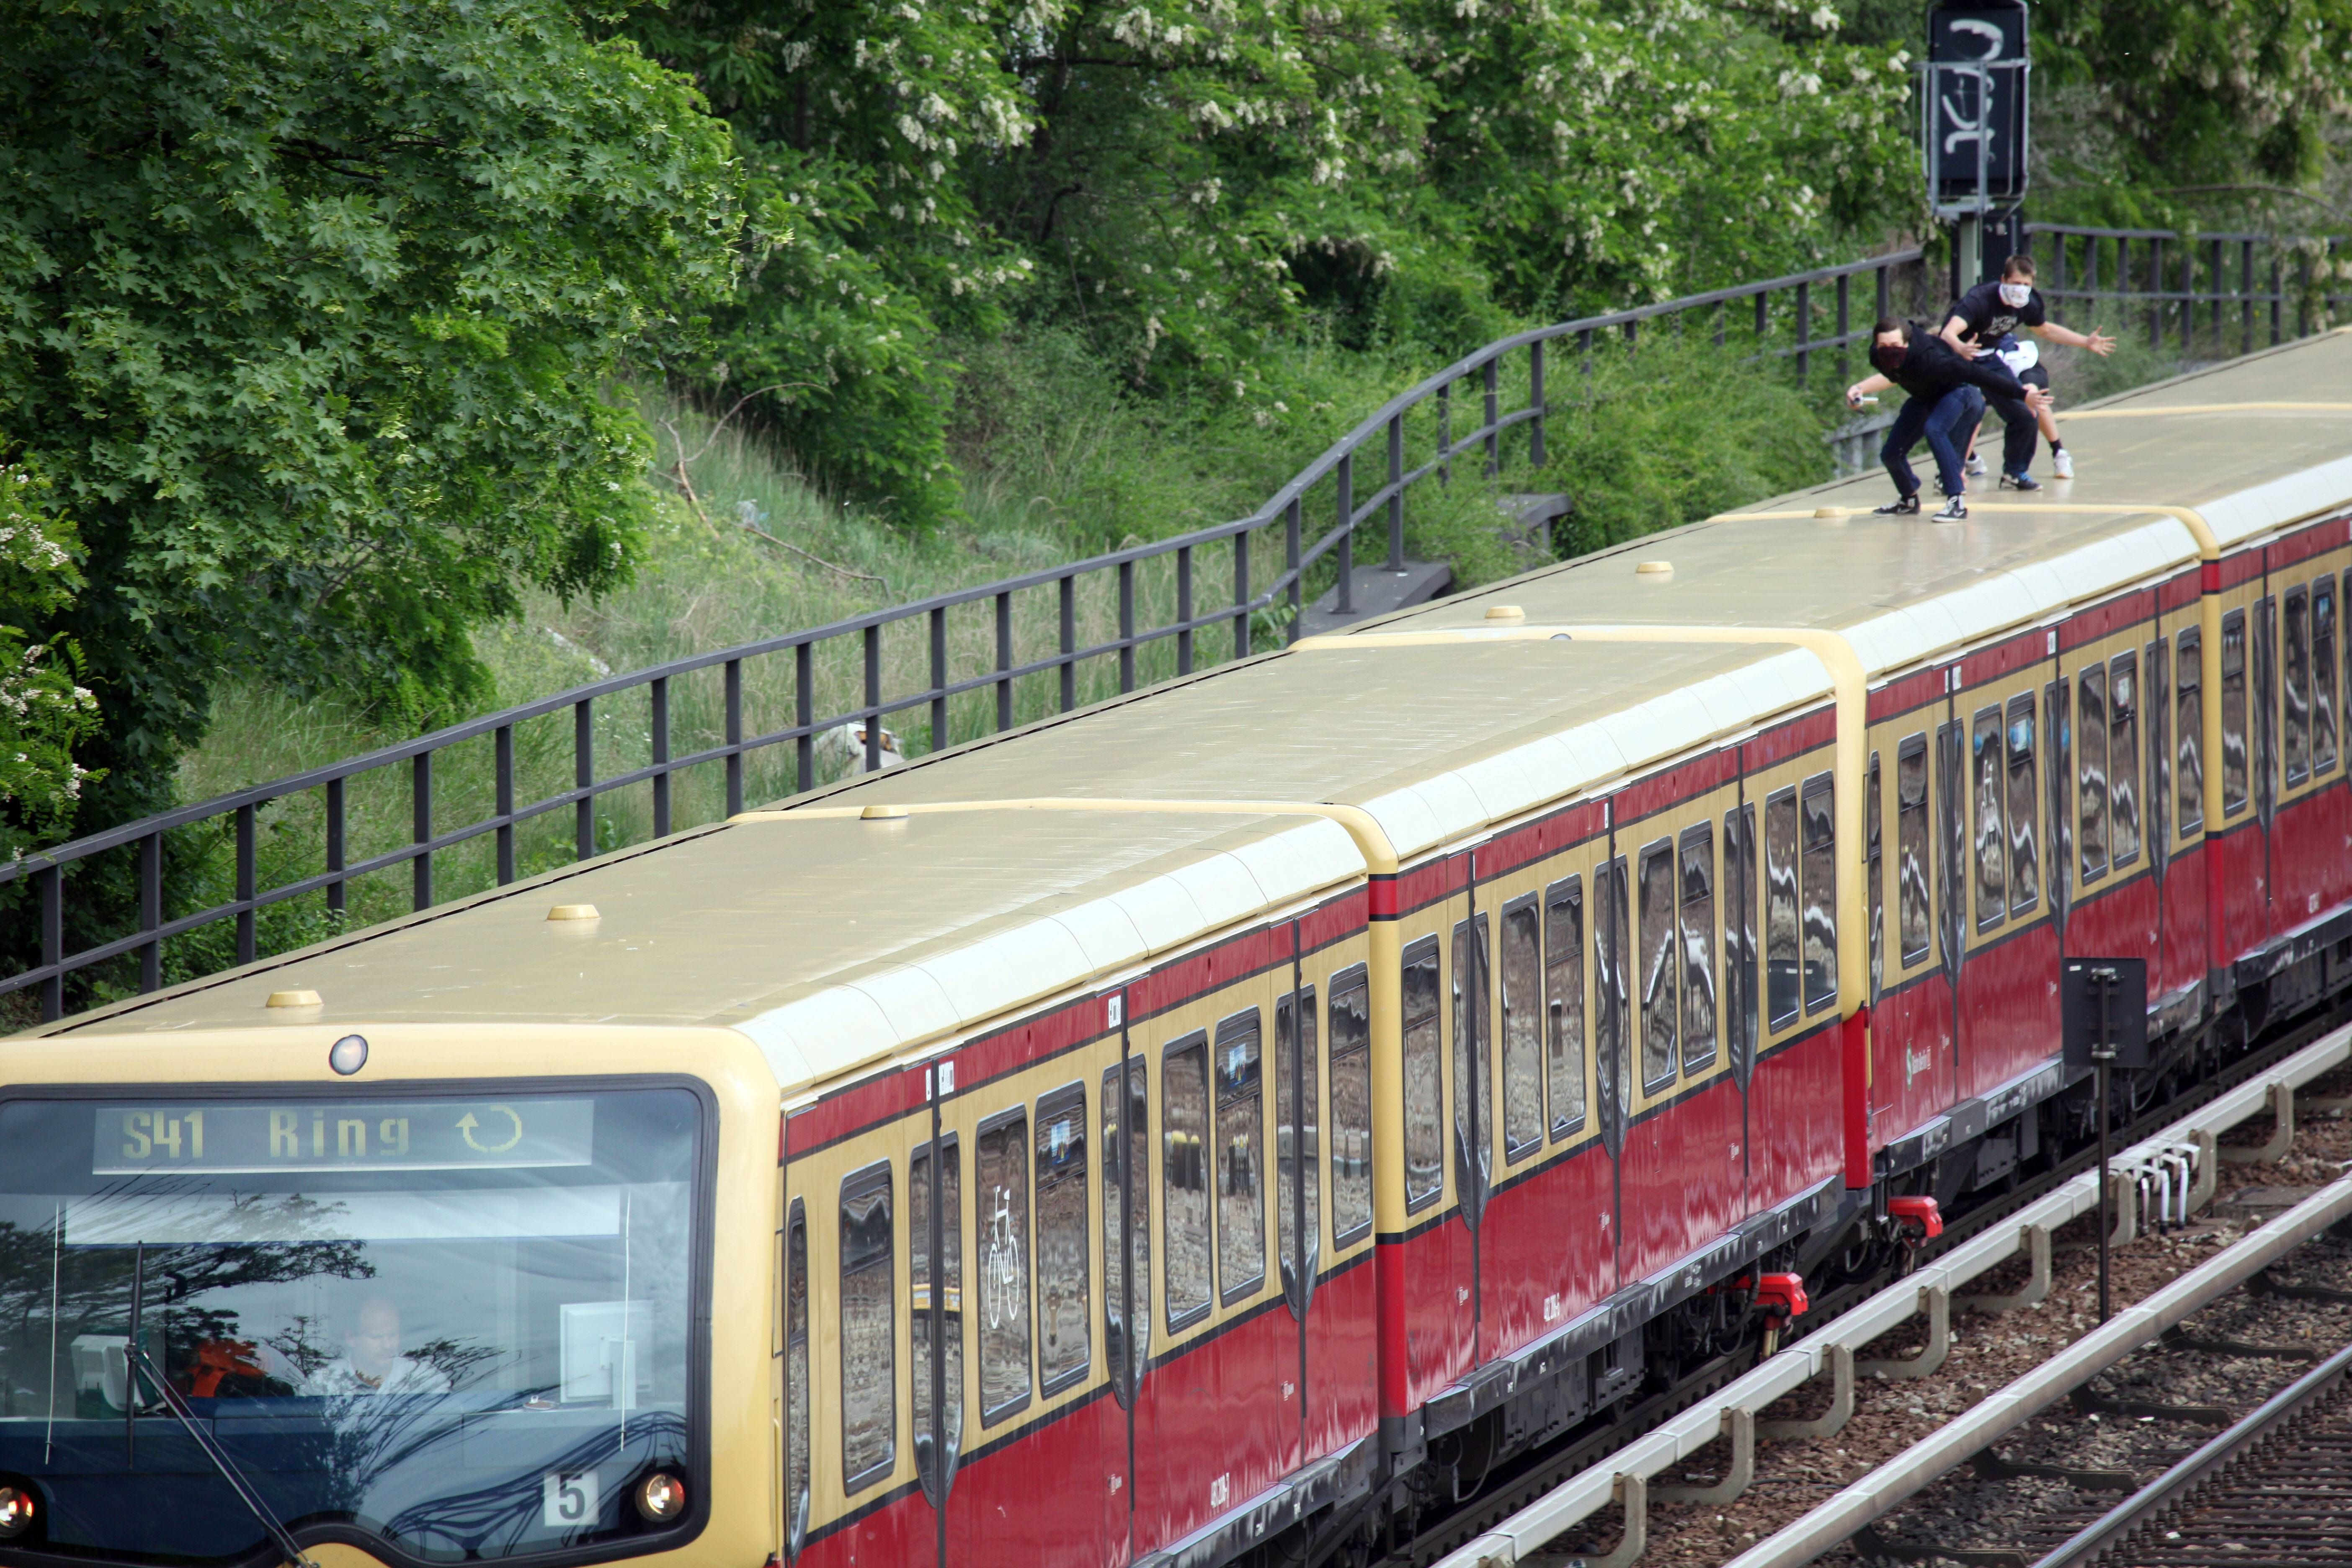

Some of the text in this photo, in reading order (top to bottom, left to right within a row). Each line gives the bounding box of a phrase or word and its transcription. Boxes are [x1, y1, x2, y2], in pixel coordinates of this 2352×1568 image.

[122, 1110, 410, 1159] S41 Ring
[559, 1473, 585, 1520] 5
